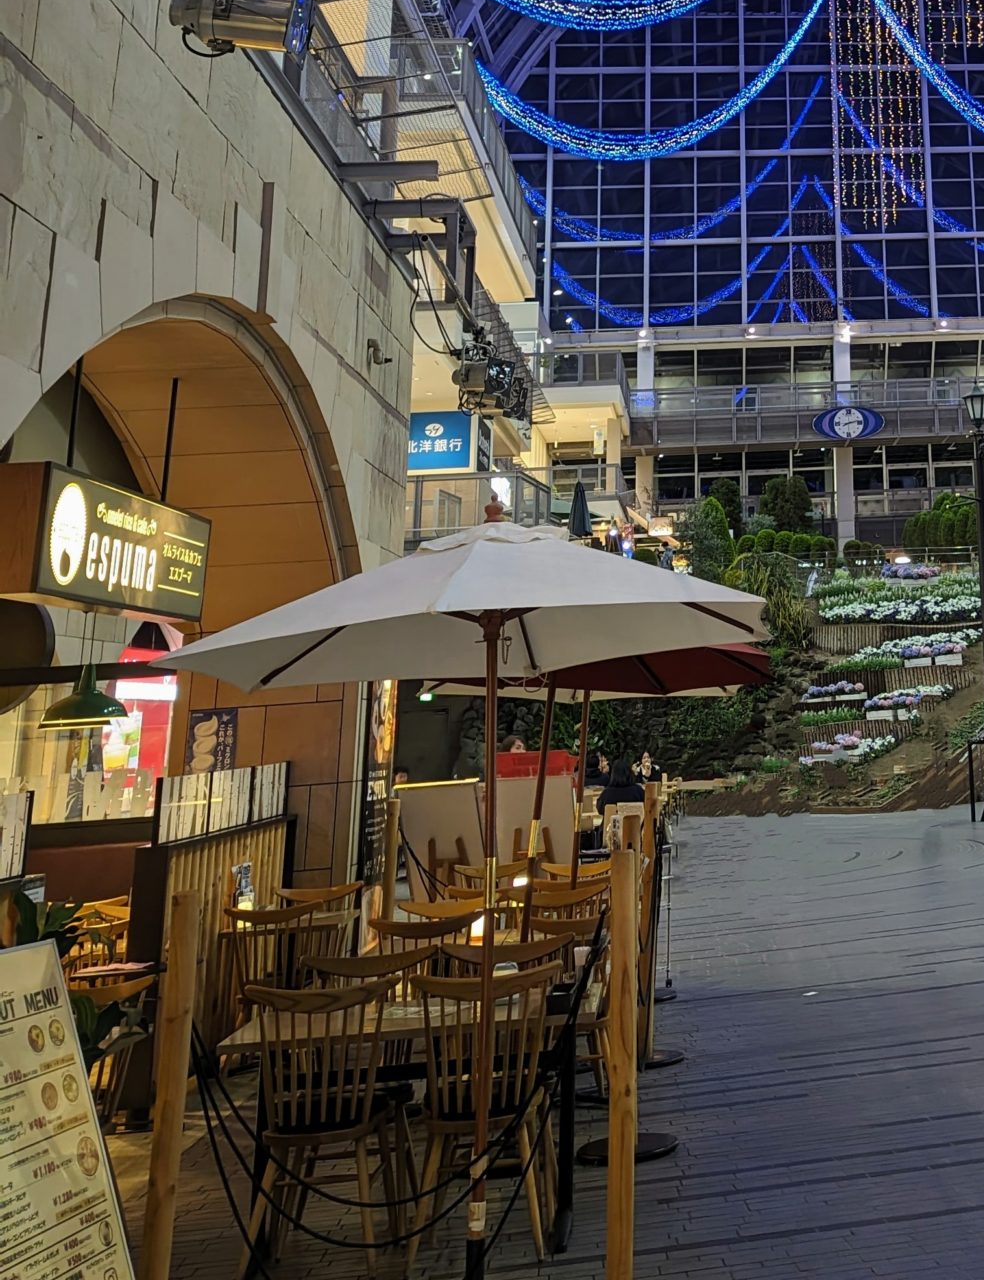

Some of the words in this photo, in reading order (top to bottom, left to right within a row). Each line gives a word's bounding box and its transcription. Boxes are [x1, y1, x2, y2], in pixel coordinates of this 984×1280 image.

[408, 438, 462, 453] 北洋銀行
[85, 531, 157, 593] espuma
[24, 986, 59, 1014] MENU
